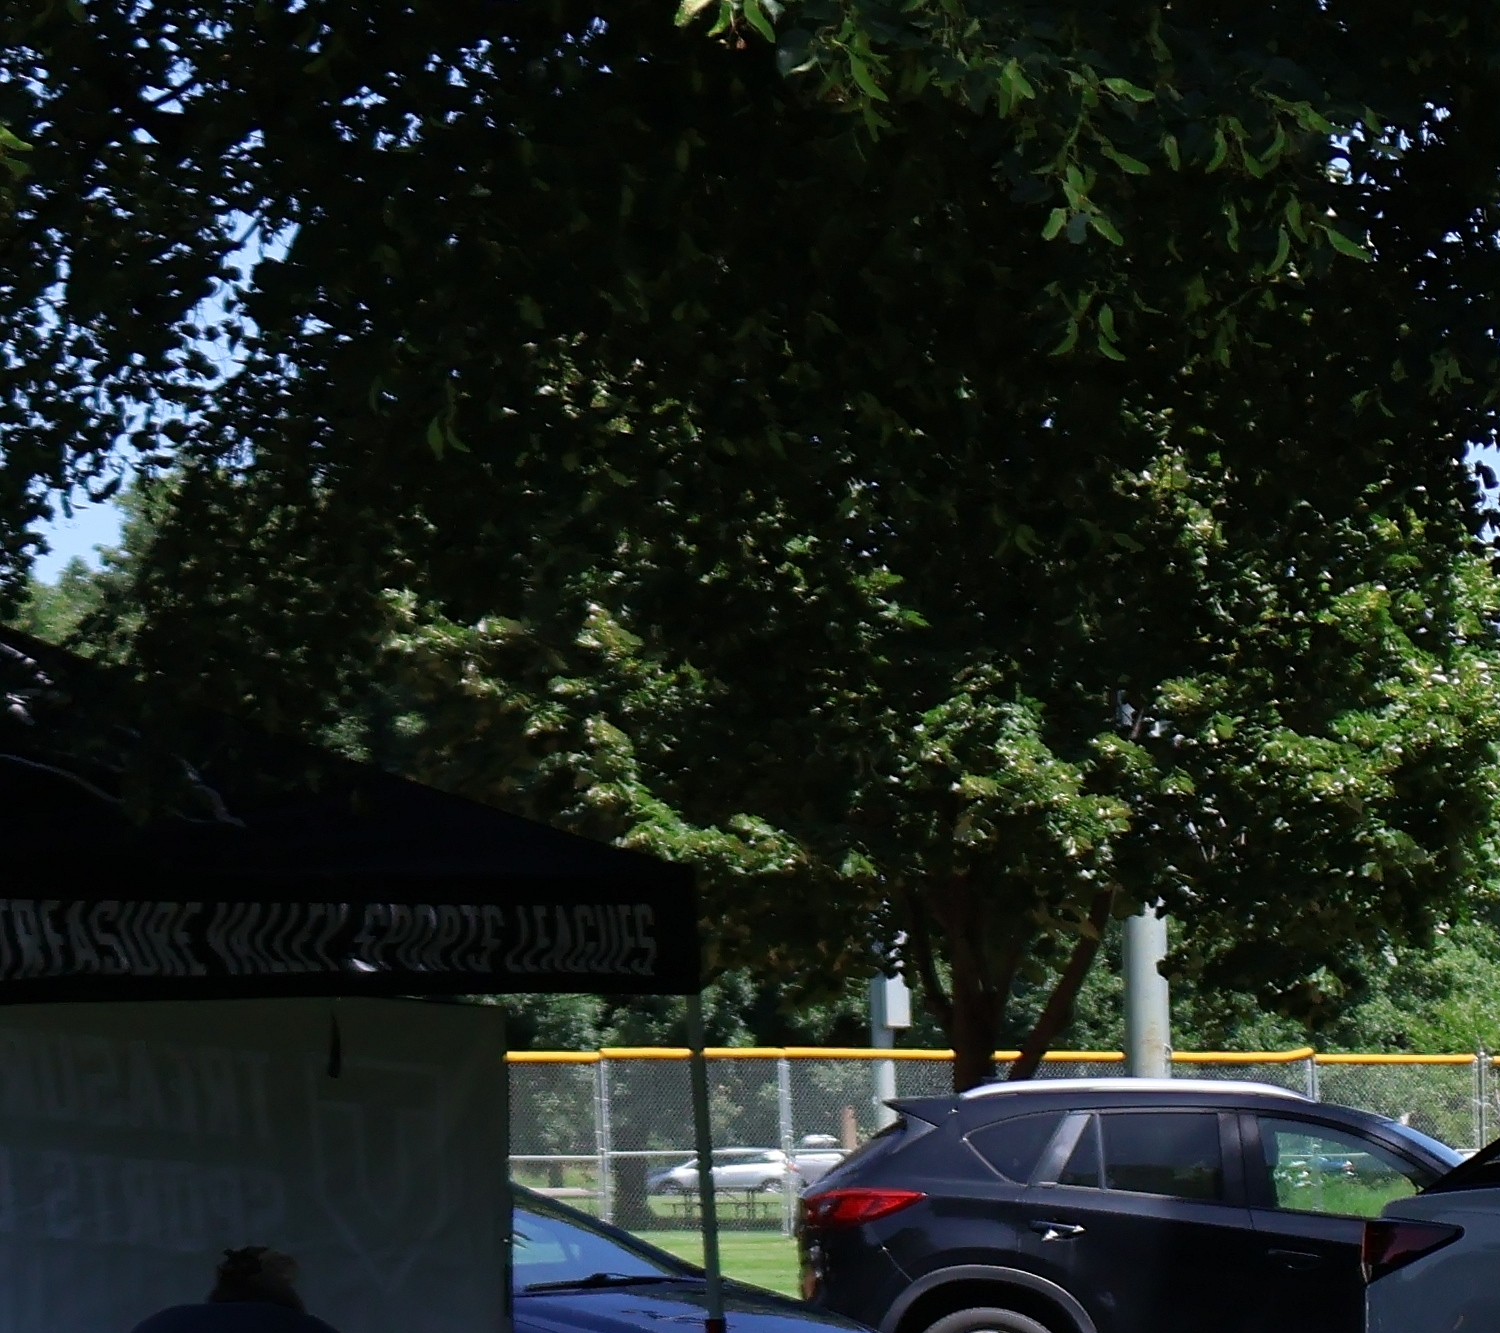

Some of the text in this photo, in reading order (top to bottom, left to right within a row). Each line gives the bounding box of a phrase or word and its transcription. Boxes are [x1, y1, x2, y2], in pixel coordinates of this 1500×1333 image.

[206, 901, 350, 976] VALLEY
[353, 903, 504, 973] SPORTS
[504, 903, 660, 976] LEAGUES
